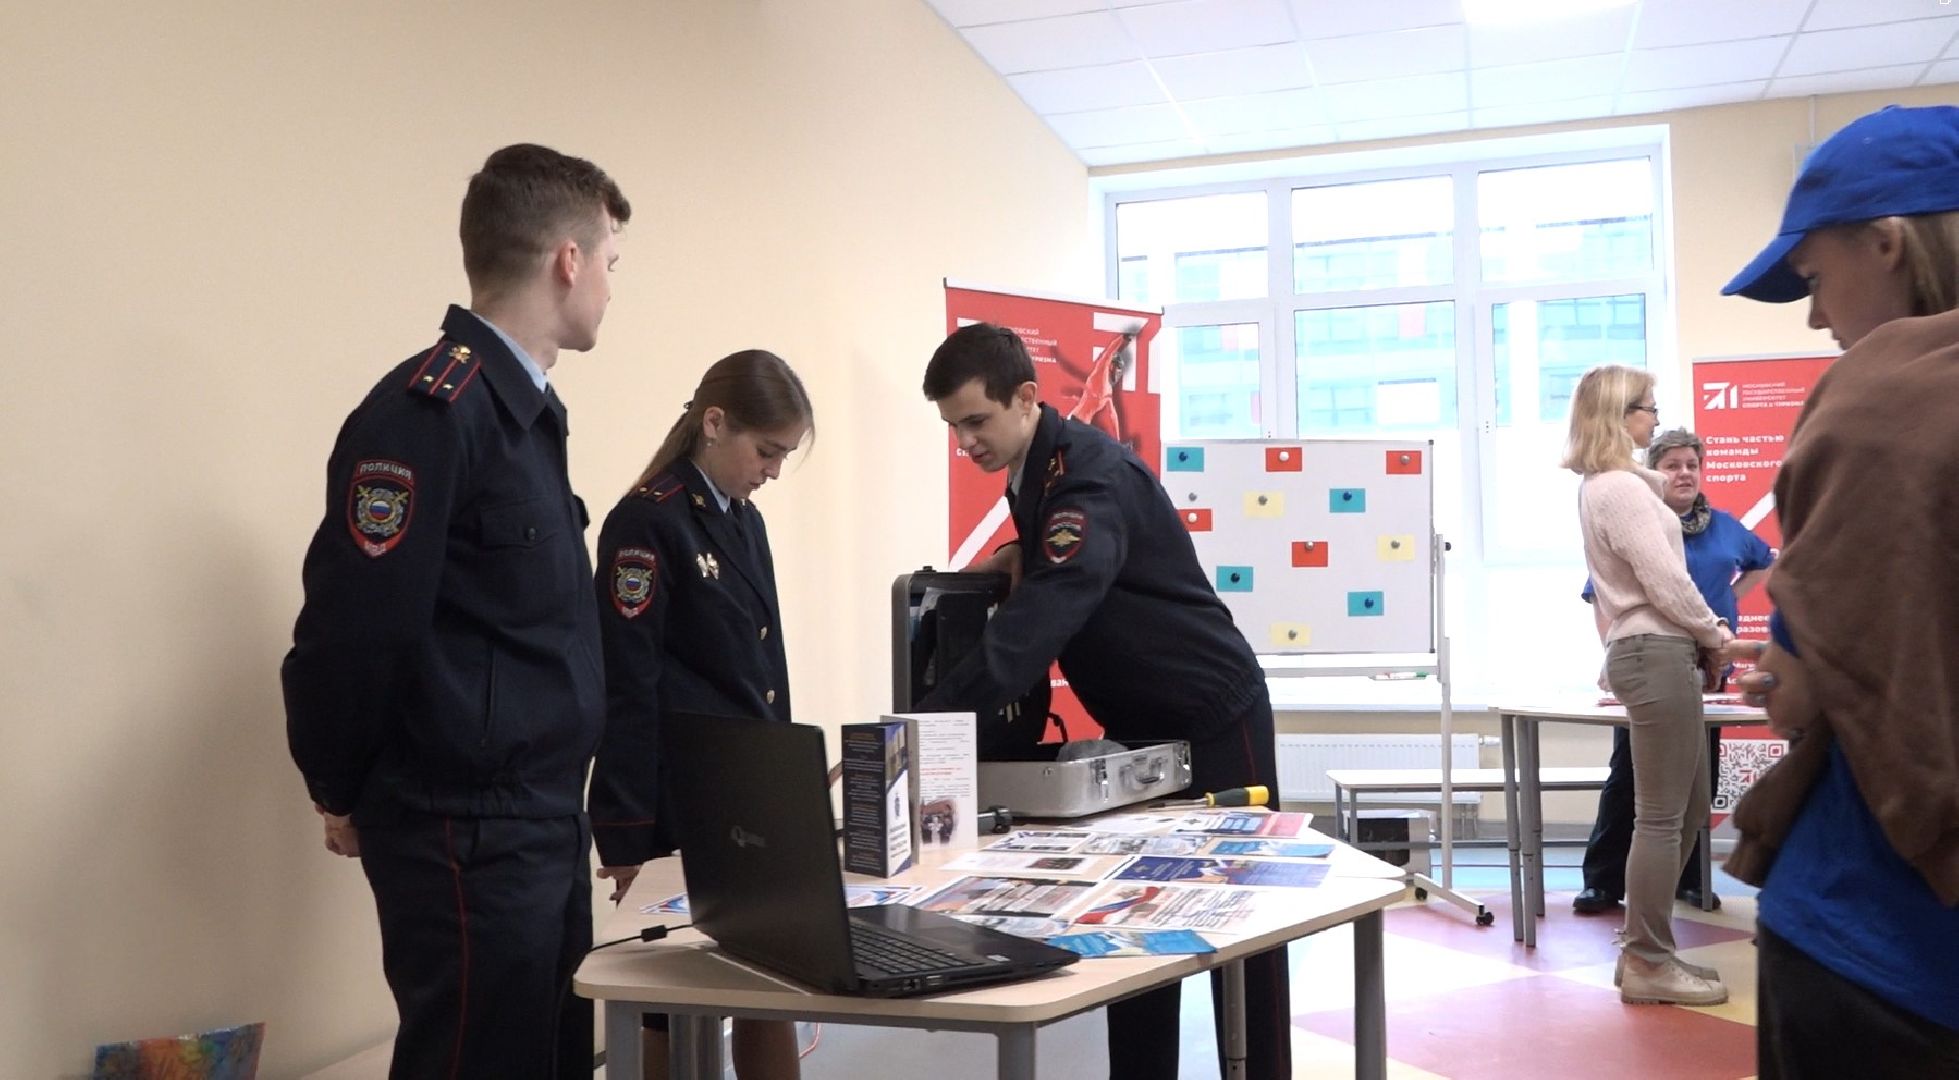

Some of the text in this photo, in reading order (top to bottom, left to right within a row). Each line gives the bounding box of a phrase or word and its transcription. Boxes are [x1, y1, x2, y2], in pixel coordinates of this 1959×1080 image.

[1705, 434, 1785, 445] Стань частью
[1705, 448, 1759, 457] команды
[1705, 460, 1782, 469] Московского
[360, 462, 412, 480] ПОЛИЦИЯ
[1705, 474, 1747, 483] спорта
